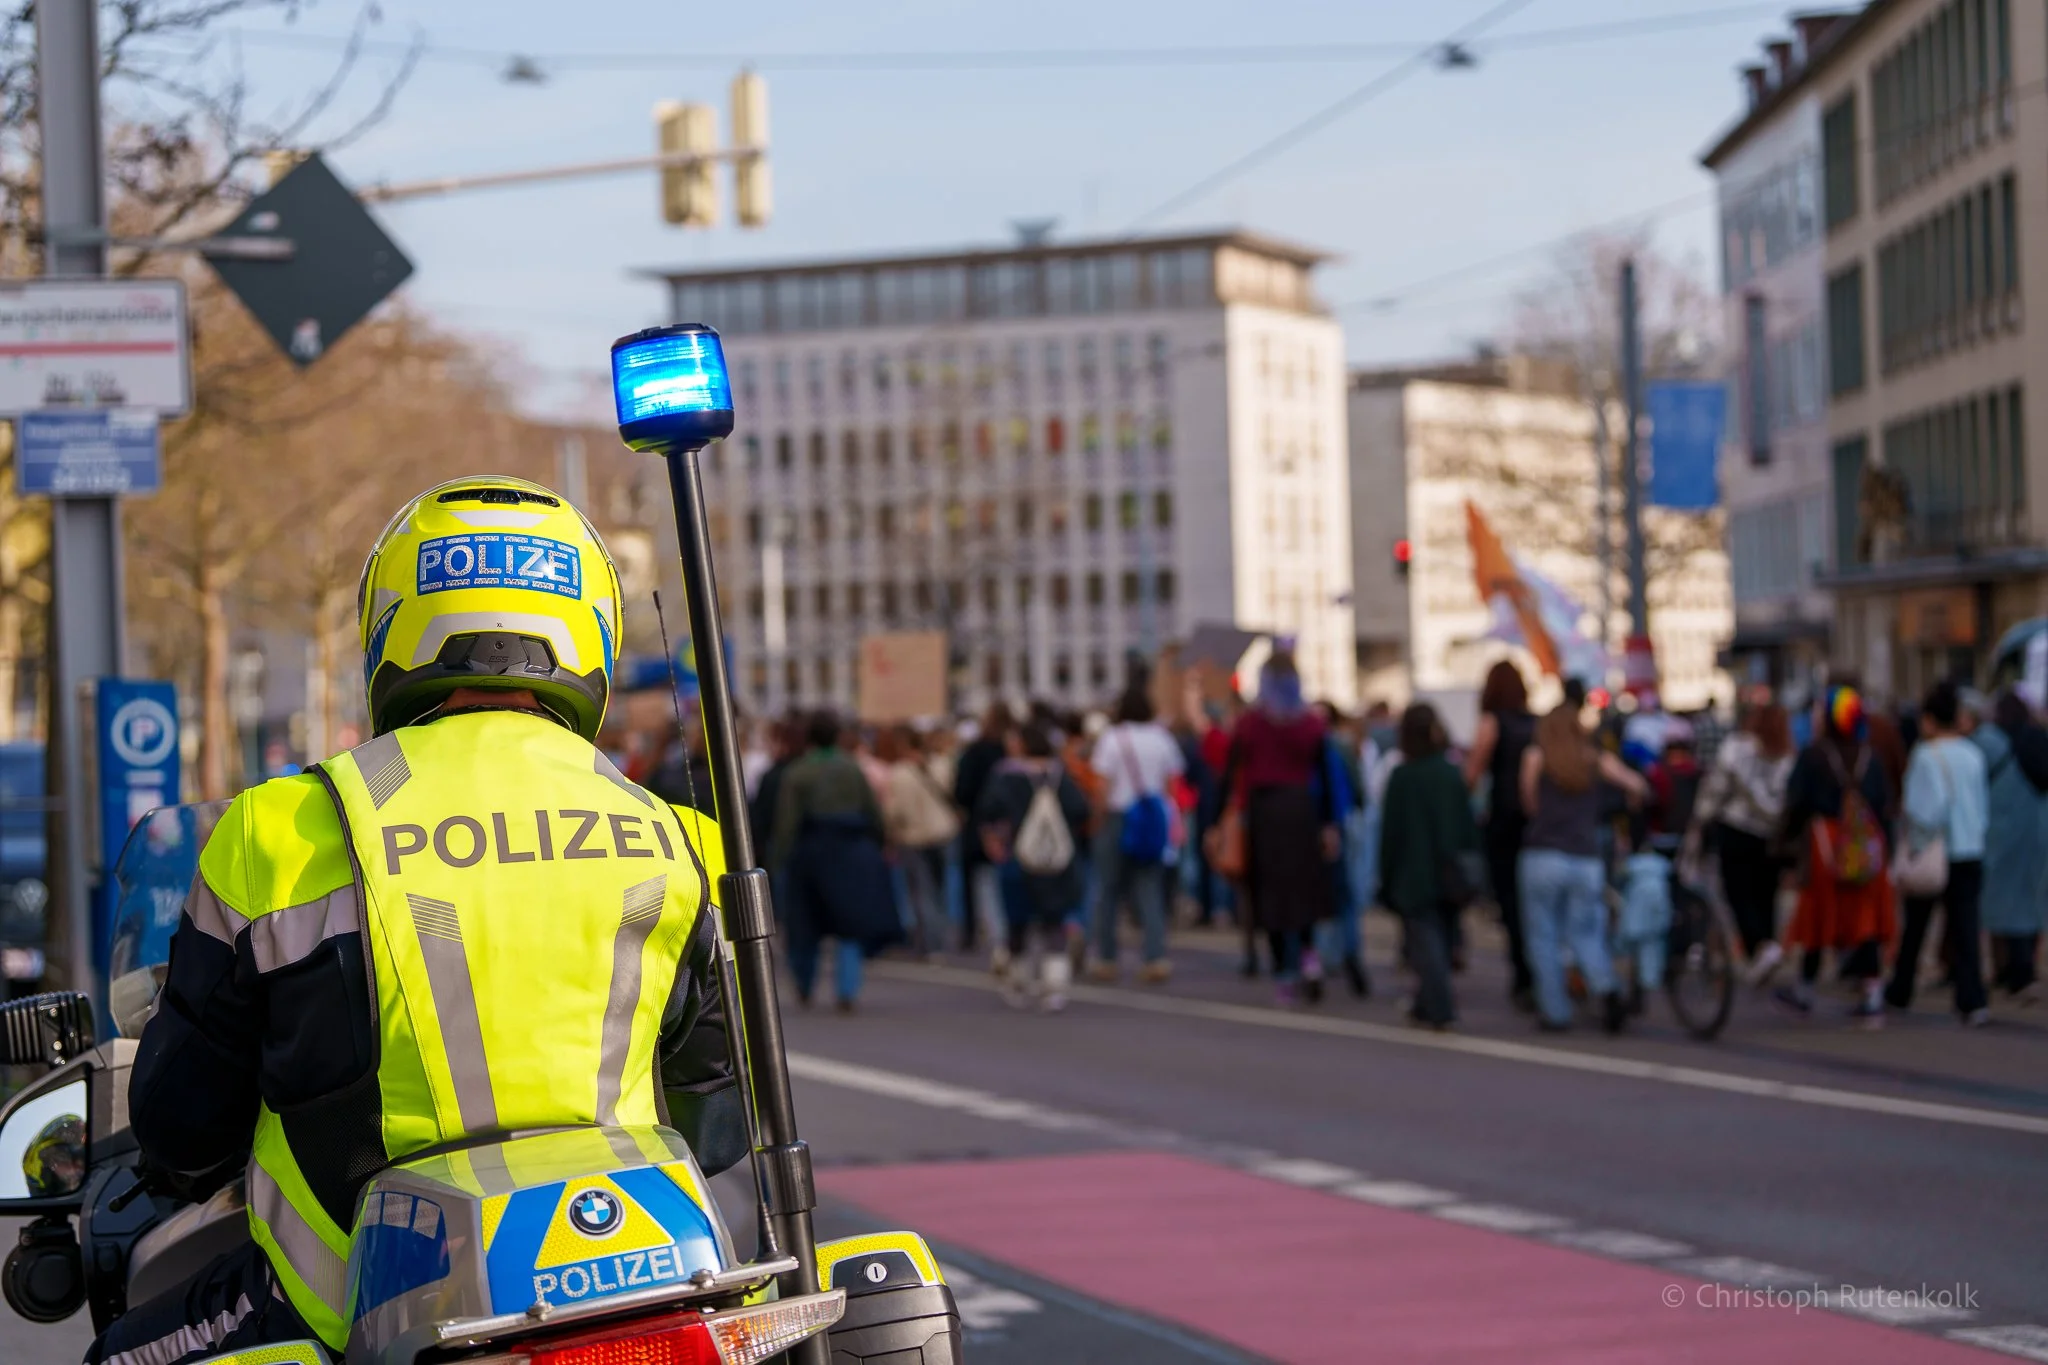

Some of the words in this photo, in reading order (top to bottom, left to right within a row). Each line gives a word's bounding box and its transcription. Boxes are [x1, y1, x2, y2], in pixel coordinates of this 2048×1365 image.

[419, 544, 578, 586] POLIZEI
[131, 716, 158, 750] P
[382, 809, 675, 875] POLIZEI
[532, 1246, 684, 1303] POLIZEI
